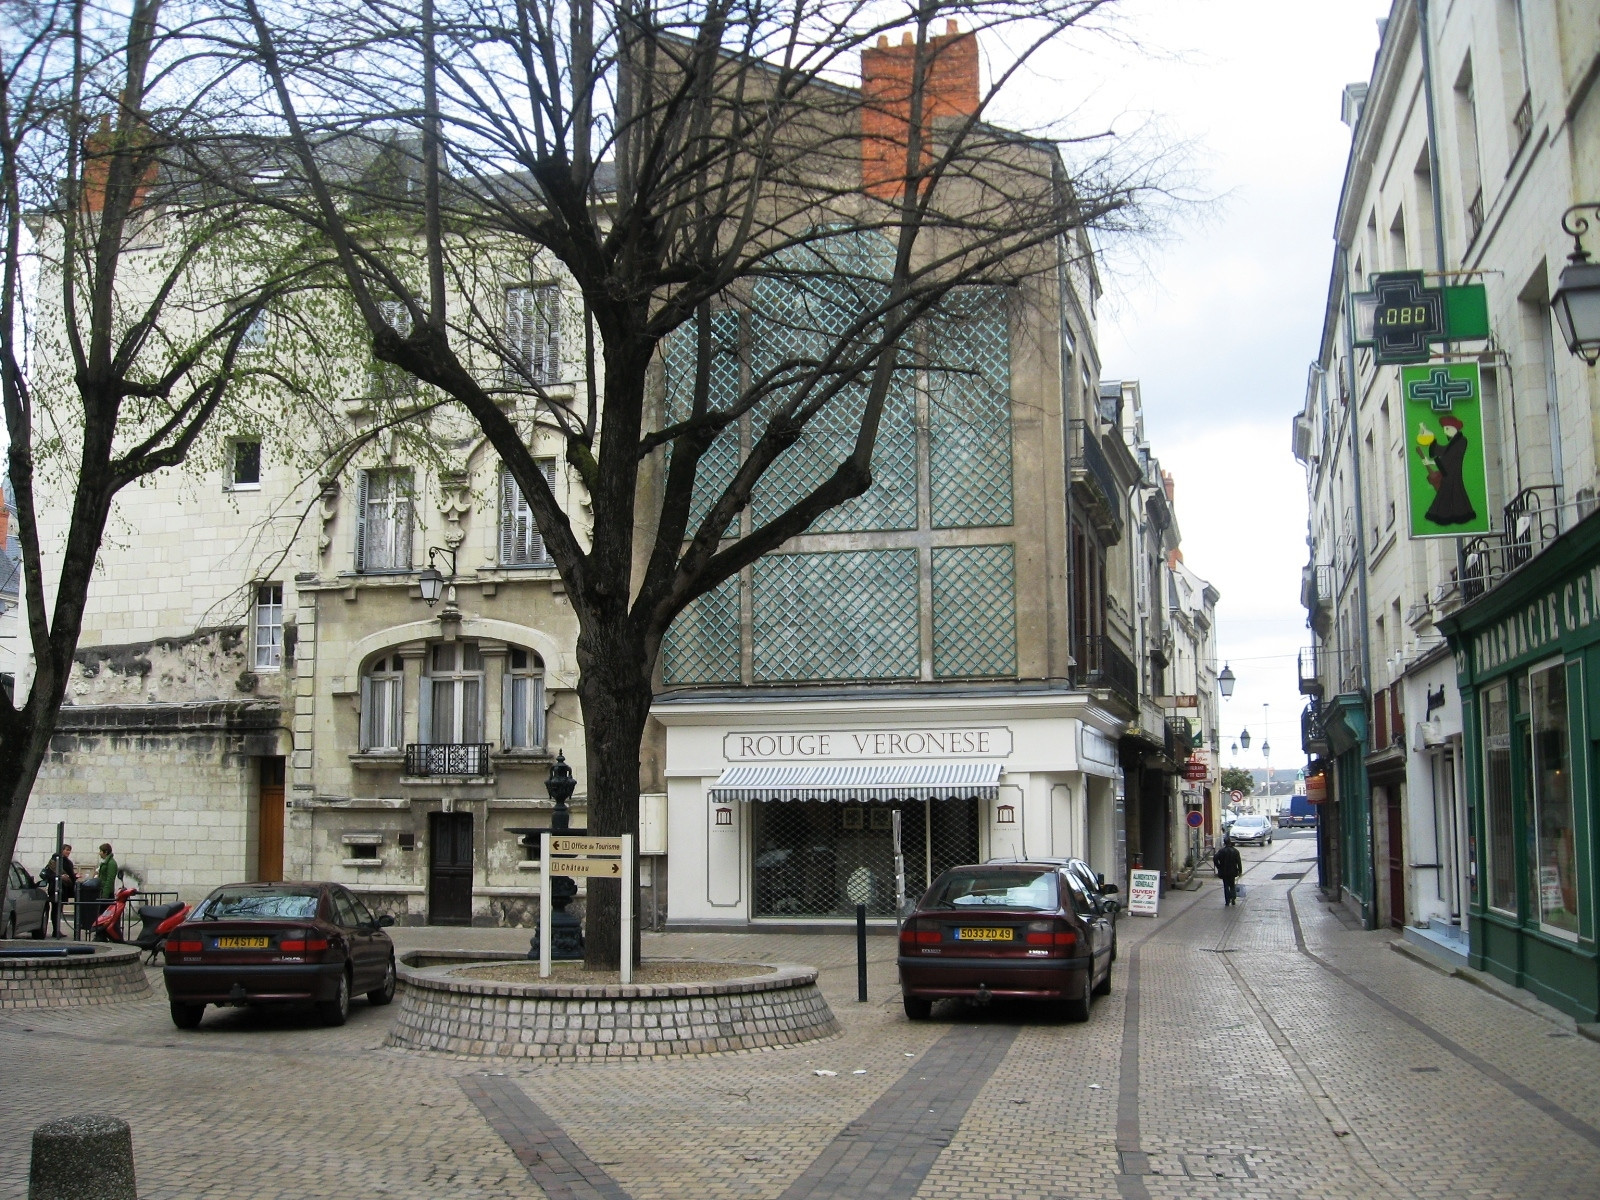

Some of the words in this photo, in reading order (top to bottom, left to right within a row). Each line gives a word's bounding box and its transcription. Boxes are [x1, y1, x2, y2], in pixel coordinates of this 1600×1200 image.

[1474, 591, 1559, 675] PHARMACIE
[739, 734, 831, 757] ROUGE
[852, 731, 990, 755] VERONESE
[571, 842, 588, 850] Office
[595, 842, 620, 851] Tourisme
[561, 863, 590, 872] Château
[961, 928, 984, 939] 5033
[985, 929, 998, 939] ZD
[998, 929, 1011, 939] 49
[219, 937, 240, 947] 1174
[240, 937, 251, 947] ST
[253, 937, 265, 947] 79
